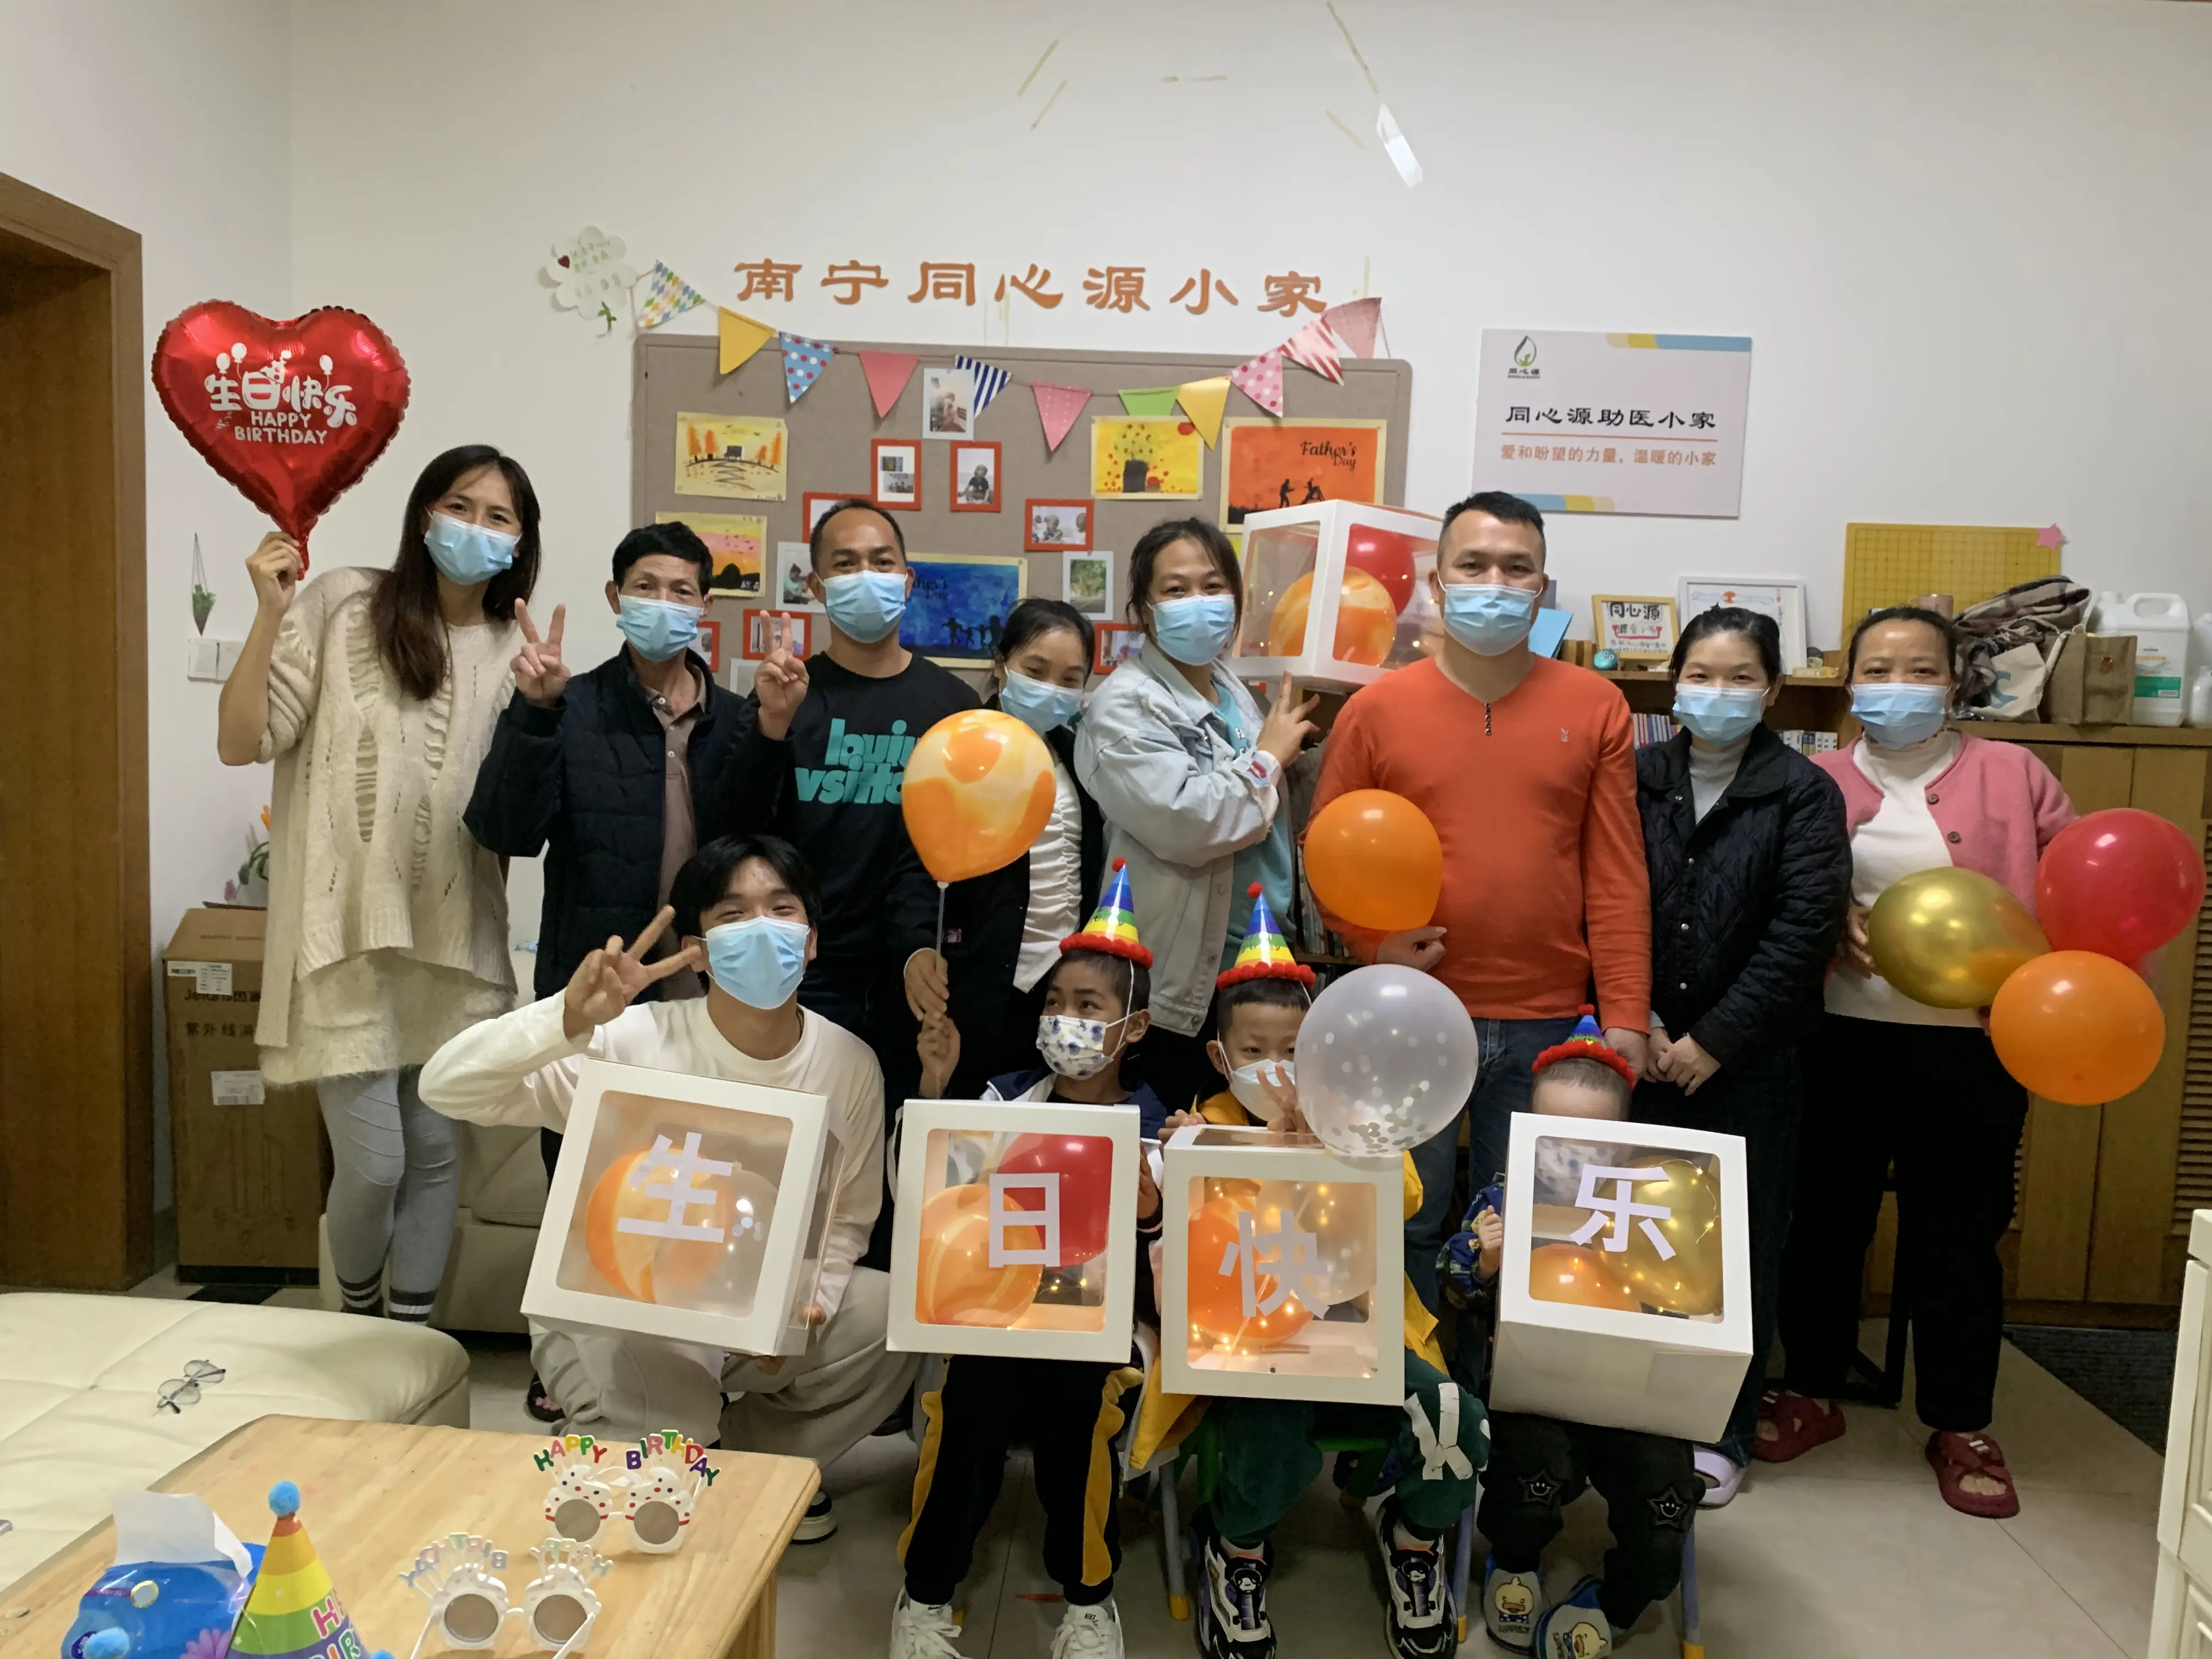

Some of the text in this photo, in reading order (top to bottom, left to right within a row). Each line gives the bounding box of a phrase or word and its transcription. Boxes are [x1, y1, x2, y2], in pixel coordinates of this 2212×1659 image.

[733, 258, 1328, 318] 南宁同心源小家
[204, 371, 358, 428] 生日快乐
[251, 411, 312, 427] HAPPY
[1505, 406, 1716, 430] 同心源助医小家
[234, 426, 328, 444] BIRTHDAY
[1300, 440, 1358, 458] Father's
[1333, 454, 1357, 471] Day
[617, 1132, 733, 1243] 生
[1569, 1163, 1676, 1261] 乐
[989, 1172, 1060, 1268] 日
[1218, 1210, 1330, 1320] 快
[533, 1429, 722, 1487] HAPPY BIRTHDAY
